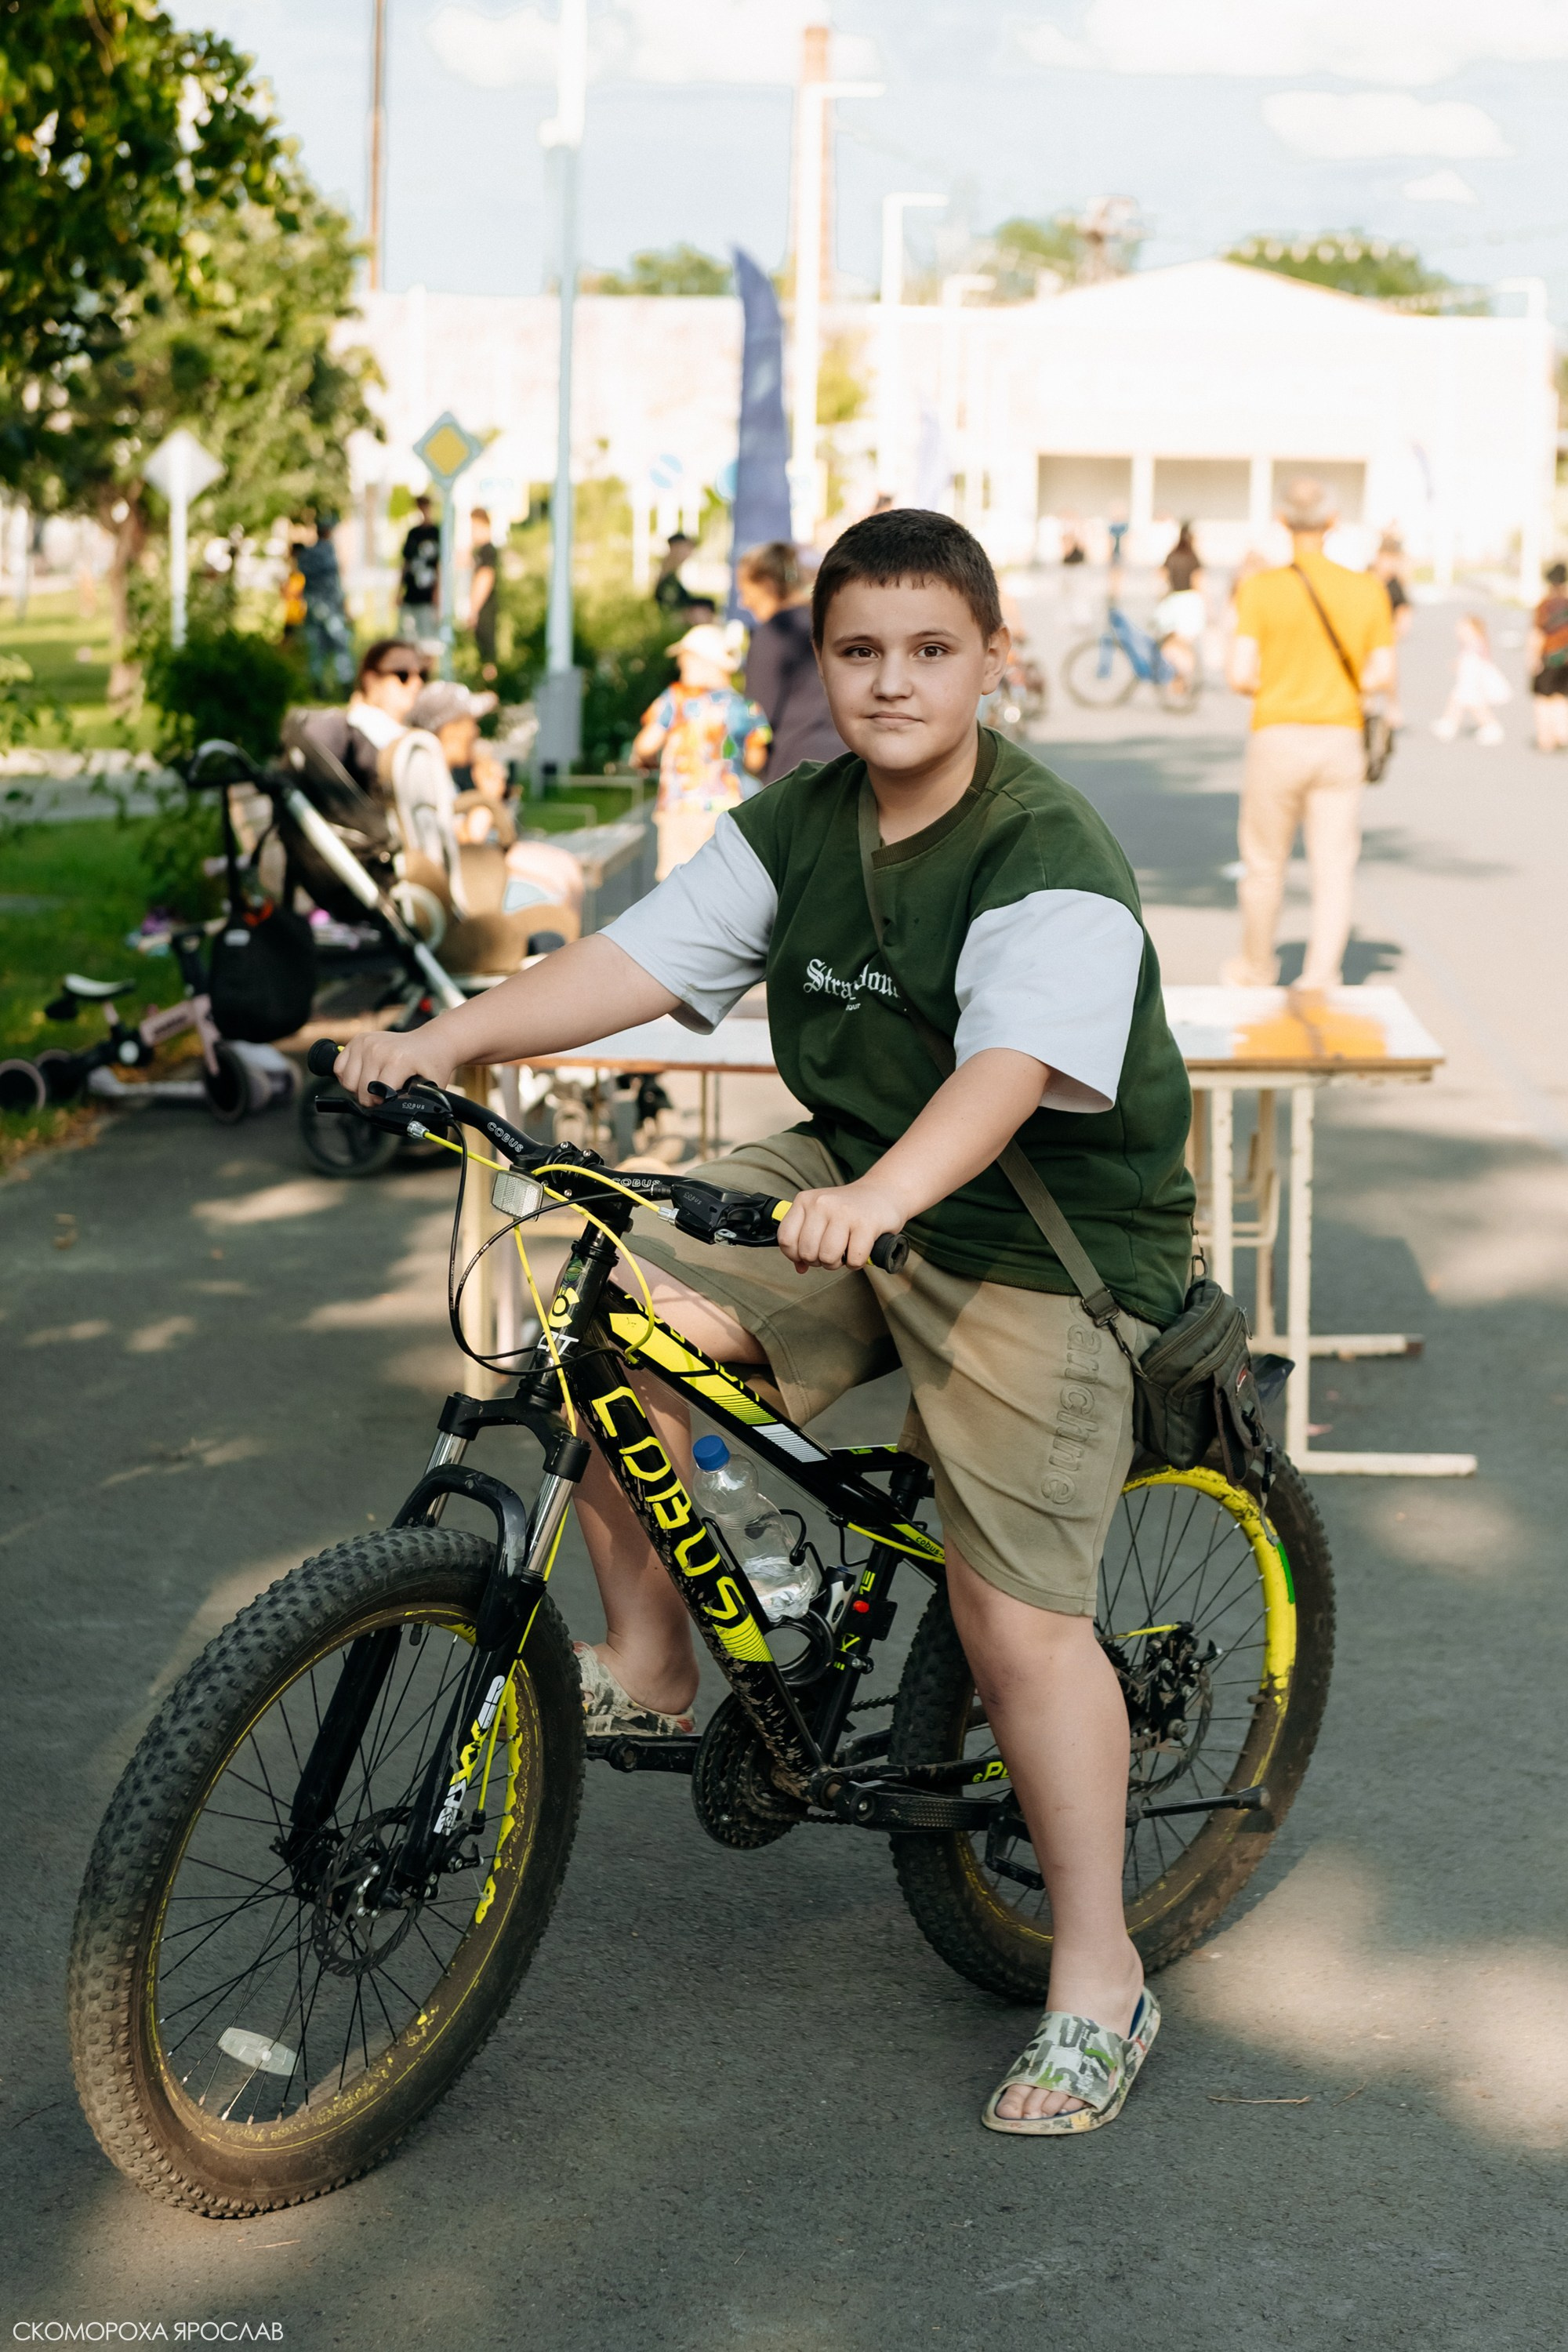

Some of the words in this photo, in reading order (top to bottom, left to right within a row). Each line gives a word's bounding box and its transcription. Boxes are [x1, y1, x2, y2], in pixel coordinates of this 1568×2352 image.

[401, 1102, 426, 1110] COBUS
[487, 1121, 524, 1153] COBUS
[684, 1192, 702, 1205] COBUS
[592, 1386, 746, 1621] COBUS
